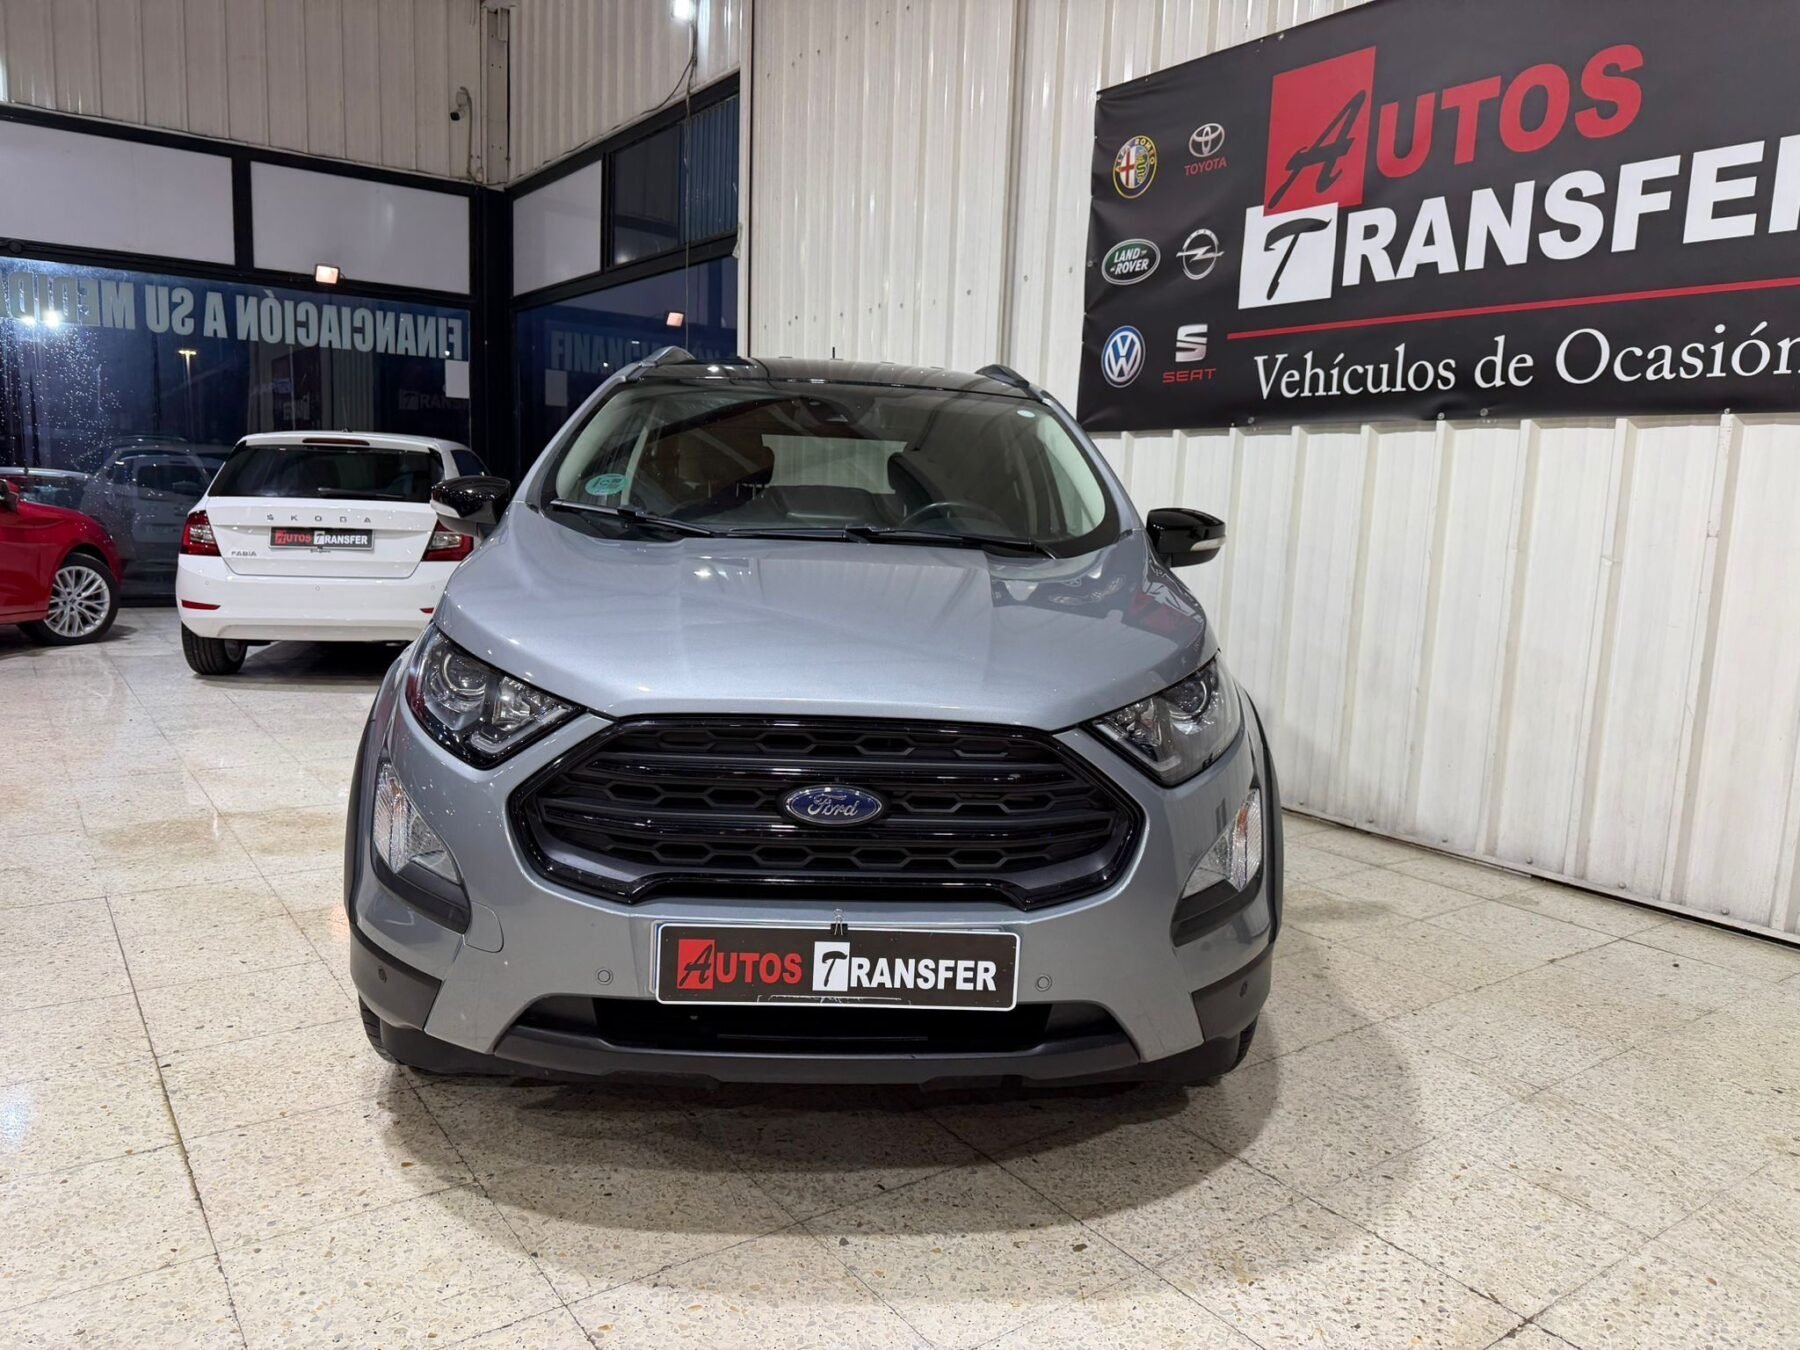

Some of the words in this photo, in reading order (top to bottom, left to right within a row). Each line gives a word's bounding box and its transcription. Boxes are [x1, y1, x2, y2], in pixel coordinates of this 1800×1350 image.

[1263, 44, 1645, 214] AUTOS
[1184, 157, 1228, 177] TOYOTA
[1113, 247, 1141, 264] LAND
[1114, 257, 1149, 275] ROVER
[1162, 368, 1217, 383] SEAT
[1254, 342, 1457, 400] Vehículos
[1474, 334, 1534, 388] de
[266, 513, 371, 523] SKODA
[275, 530, 312, 545] AUTOS
[313, 530, 368, 545] TRANSFER
[807, 794, 860, 816] Ford
[677, 938, 803, 991] AUTOS
[812, 941, 997, 992] TRANSFER
